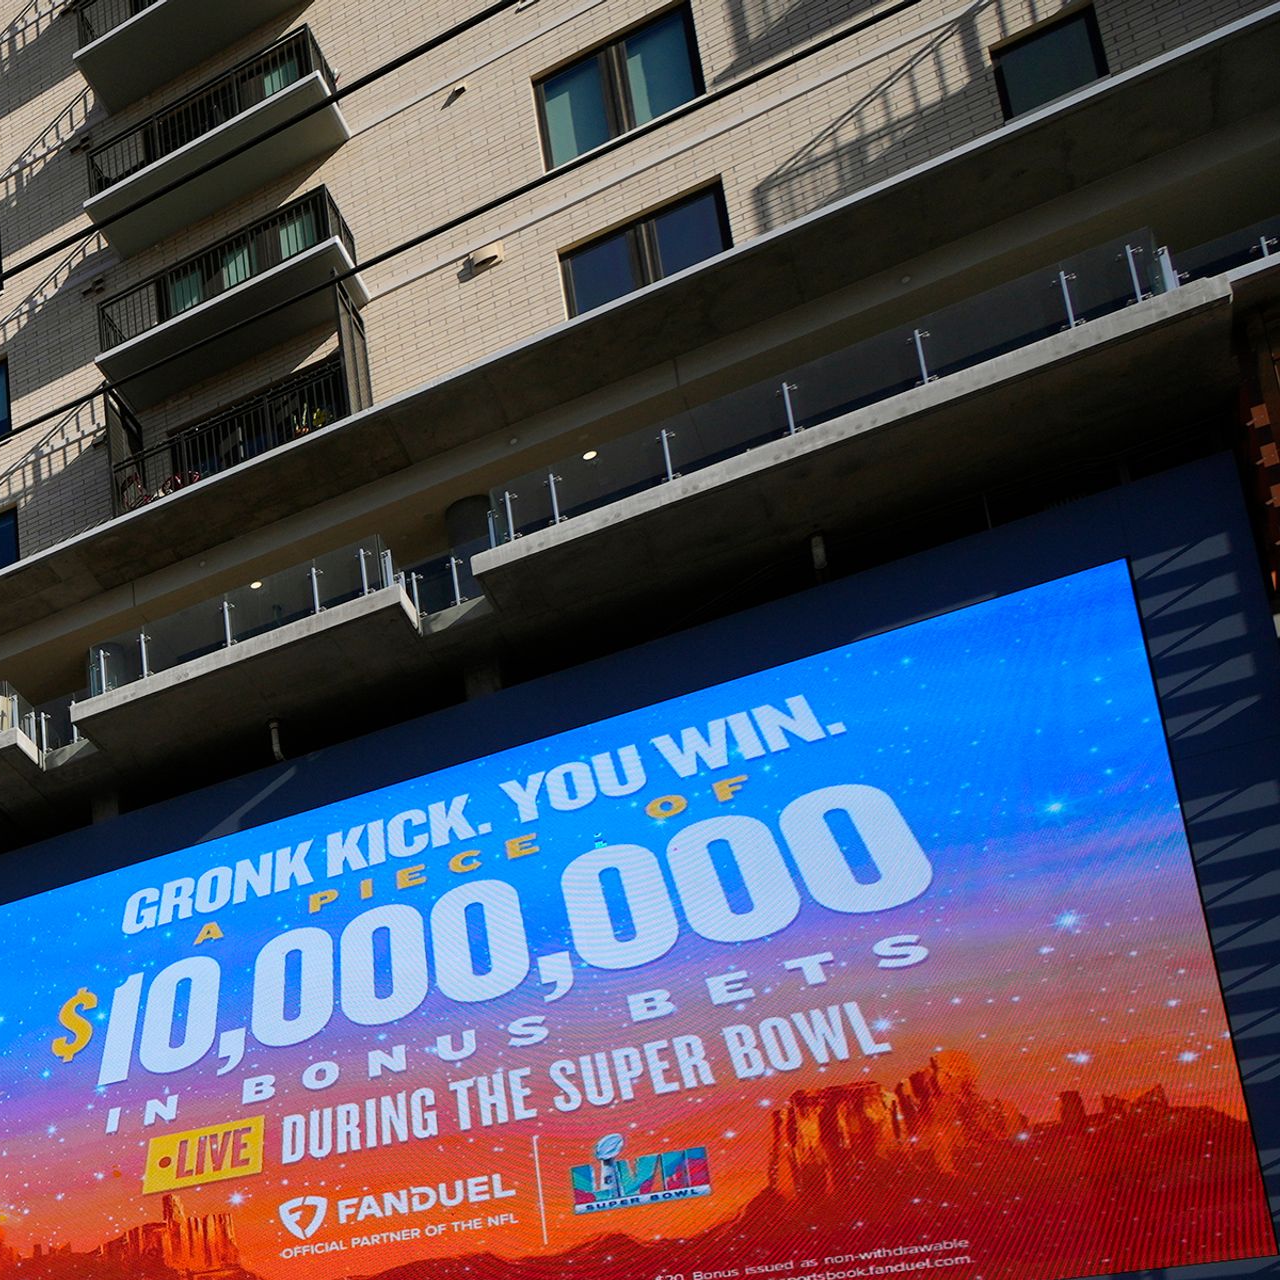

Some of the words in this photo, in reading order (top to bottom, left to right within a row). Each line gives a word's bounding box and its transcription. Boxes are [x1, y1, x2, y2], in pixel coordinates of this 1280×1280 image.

[121, 838, 315, 935] GRONK
[326, 793, 492, 878] KICK.
[498, 743, 647, 824] YOU
[648, 694, 847, 778] WIN.
[193, 922, 224, 946] A
[308, 832, 540, 914] PIECE
[645, 774, 749, 819] OF
[51, 783, 934, 1087] $10,000,000
[104, 1094, 180, 1134] IN
[242, 1016, 550, 1105] BONUS
[626, 934, 930, 1022] BETS
[280, 1086, 439, 1164] DURING
[449, 1066, 538, 1131] THE
[549, 1033, 716, 1114] SUPER
[721, 1000, 893, 1080] BOWL
[175, 1125, 253, 1180] LIVE
[338, 1173, 516, 1224] FANDUEL
[585, 1198, 641, 1211] SUPER
[650, 1188, 700, 1201] BOWL
[281, 1240, 348, 1260] OFFICIAL
[351, 1228, 421, 1249] PARTNER
[425, 1222, 447, 1237] OF
[451, 1218, 483, 1233] THE
[487, 1213, 519, 1227] NFL
[744, 1260, 794, 1275] issued
[800, 1257, 817, 1267] as
[824, 1238, 970, 1265] non-withdrawable
